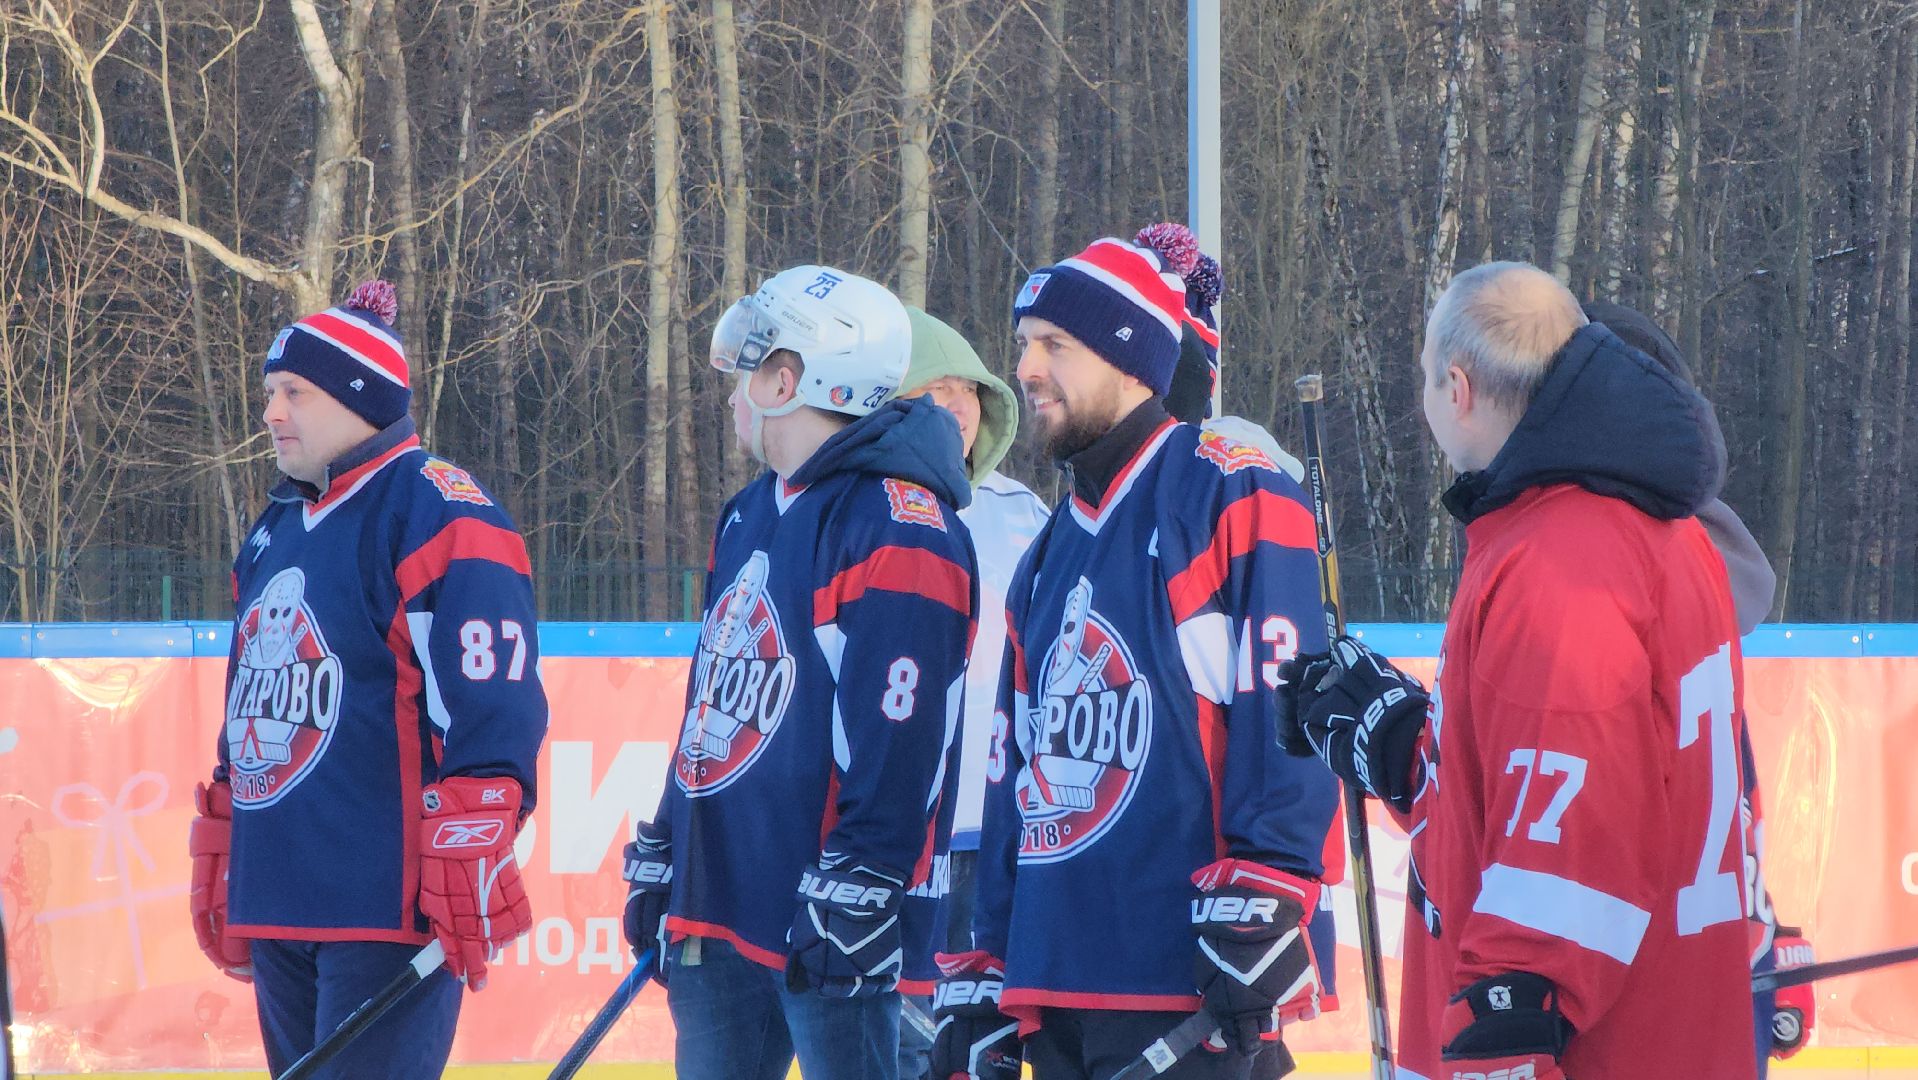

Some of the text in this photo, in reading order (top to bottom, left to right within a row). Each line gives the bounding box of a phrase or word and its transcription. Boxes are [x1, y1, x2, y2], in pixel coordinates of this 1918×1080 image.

[804, 276, 838, 300] 23
[862, 386, 890, 408] 23
[458, 619, 528, 681] 87
[1237, 617, 1298, 692] 13
[881, 656, 920, 722] 8
[1504, 748, 1588, 845] 77
